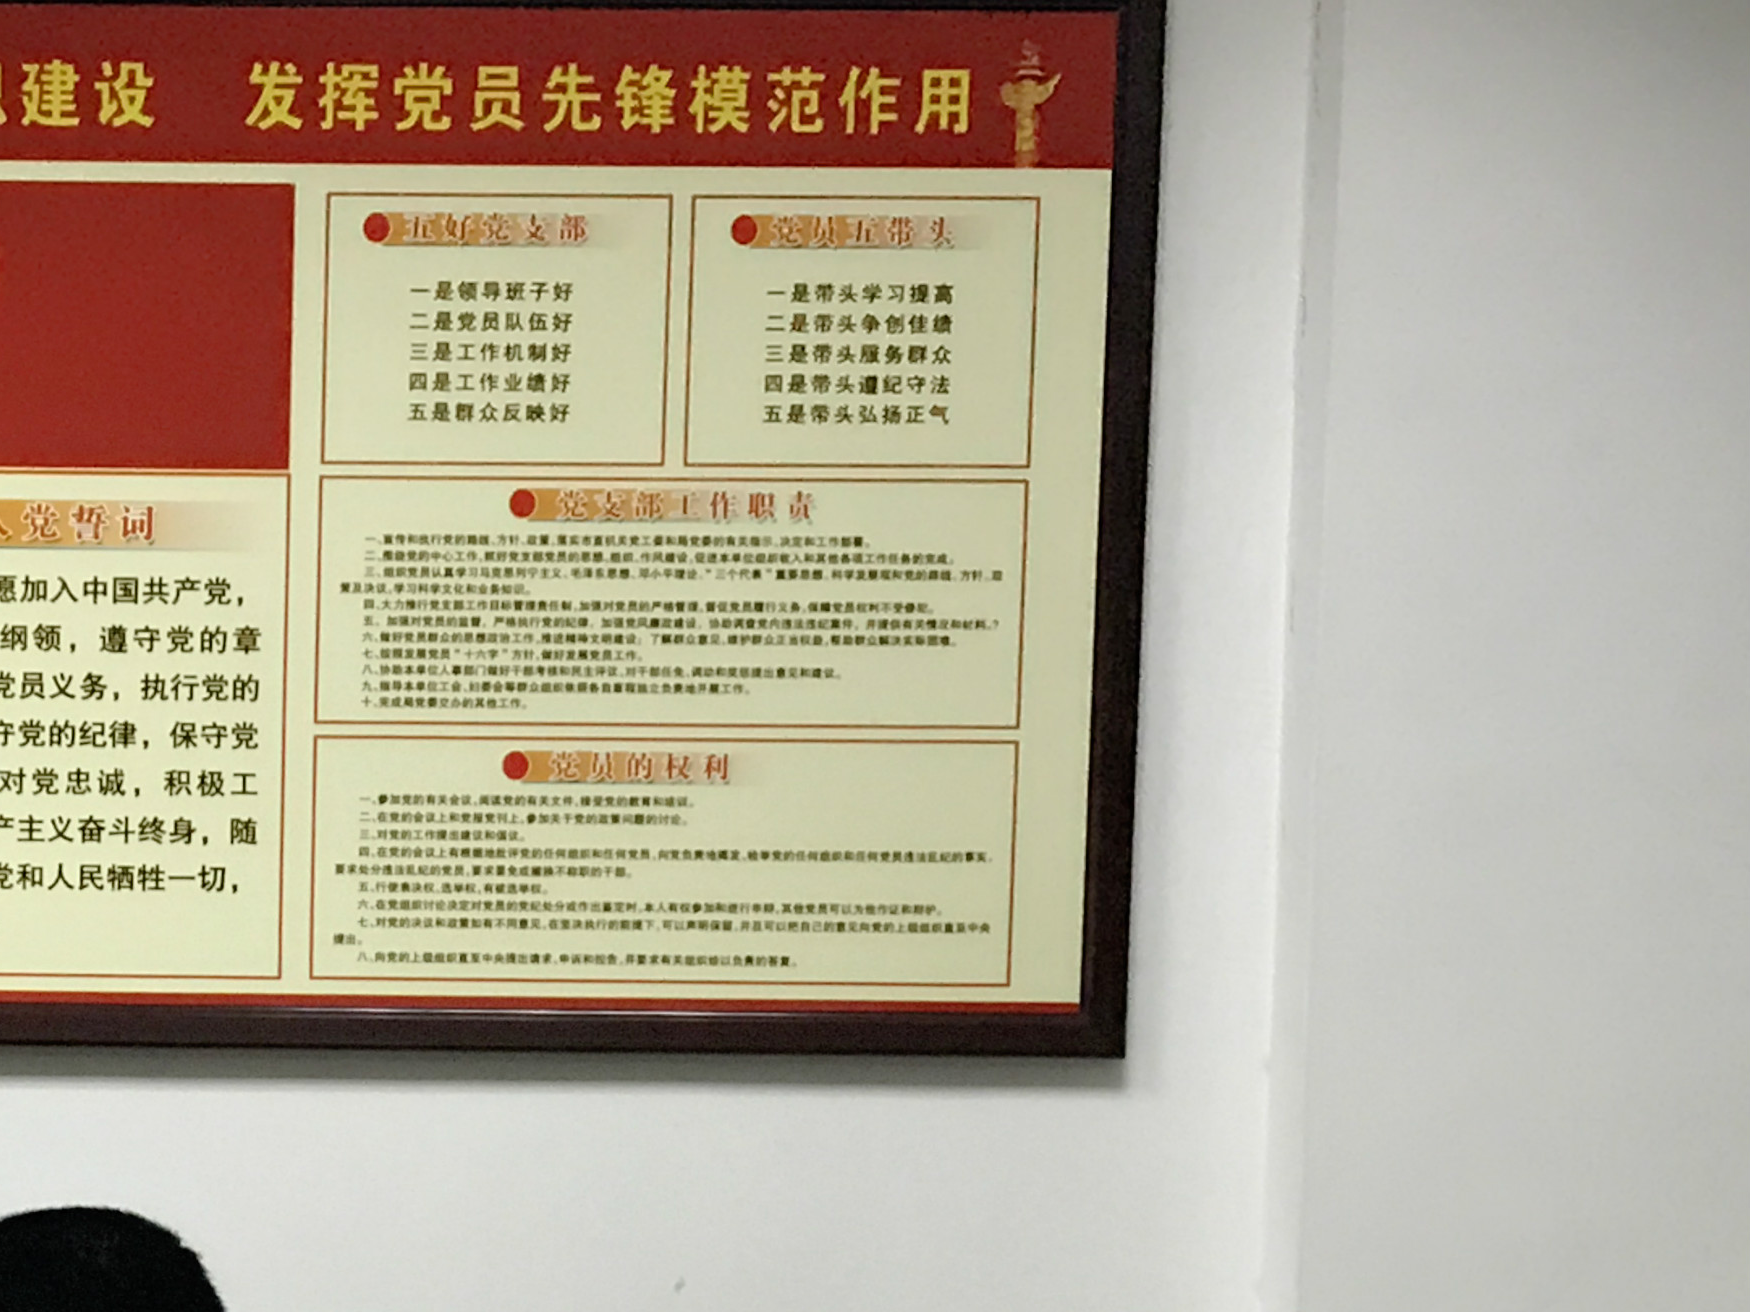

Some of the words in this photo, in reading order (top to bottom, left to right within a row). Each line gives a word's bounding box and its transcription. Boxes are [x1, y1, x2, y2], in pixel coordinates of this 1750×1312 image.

[245, 61, 976, 138] 发挥党员先锋模范作用
[403, 213, 590, 245] 五好党支部
[770, 215, 956, 247] 党员五带头
[409, 279, 575, 304] 一是领导班子好
[765, 281, 957, 306] 一是带头学习提高
[408, 309, 574, 334] 二是党员队伍好
[763, 311, 954, 336] 二是带头争创佳绩
[409, 340, 573, 364] 三是工作机制好
[764, 342, 953, 366] 三是带头服务群众
[407, 370, 572, 395] 四是工作业绩好
[763, 372, 952, 397] 四是带头遵纪守法
[406, 400, 571, 425] 五是群众反映好
[761, 402, 951, 427] 五是带头弘扬正气
[556, 489, 816, 524] 党支部工作职责
[550, 751, 732, 783] 党员的权利
